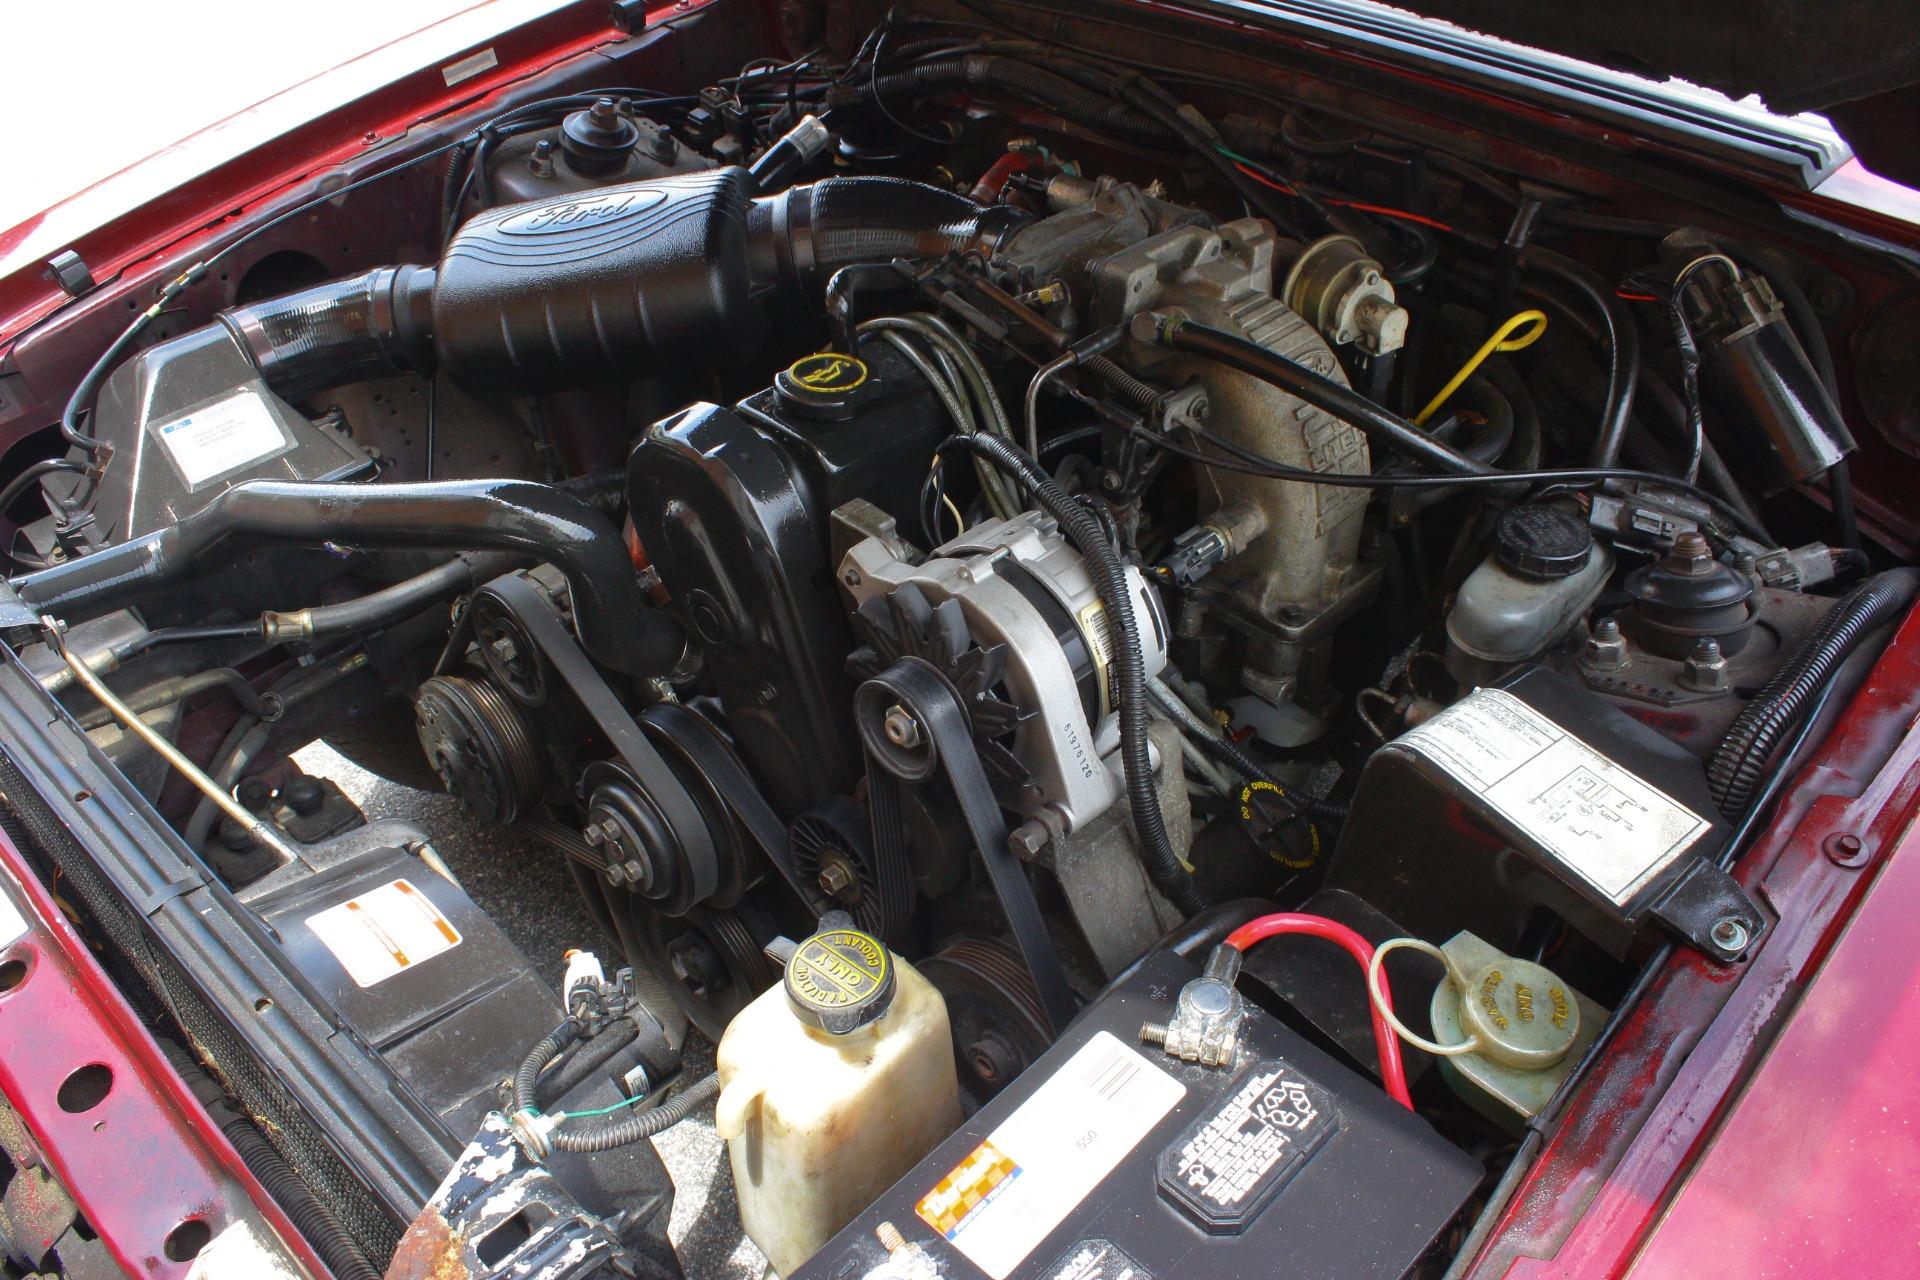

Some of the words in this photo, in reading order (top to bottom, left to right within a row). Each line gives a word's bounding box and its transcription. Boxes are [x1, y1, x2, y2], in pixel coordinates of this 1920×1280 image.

[527, 195, 636, 230] Ford
[1241, 787, 1251, 802] NOT
[1251, 781, 1285, 797] OVERFILL
[834, 936, 880, 968] COOLANT
[815, 952, 862, 987] ONLY
